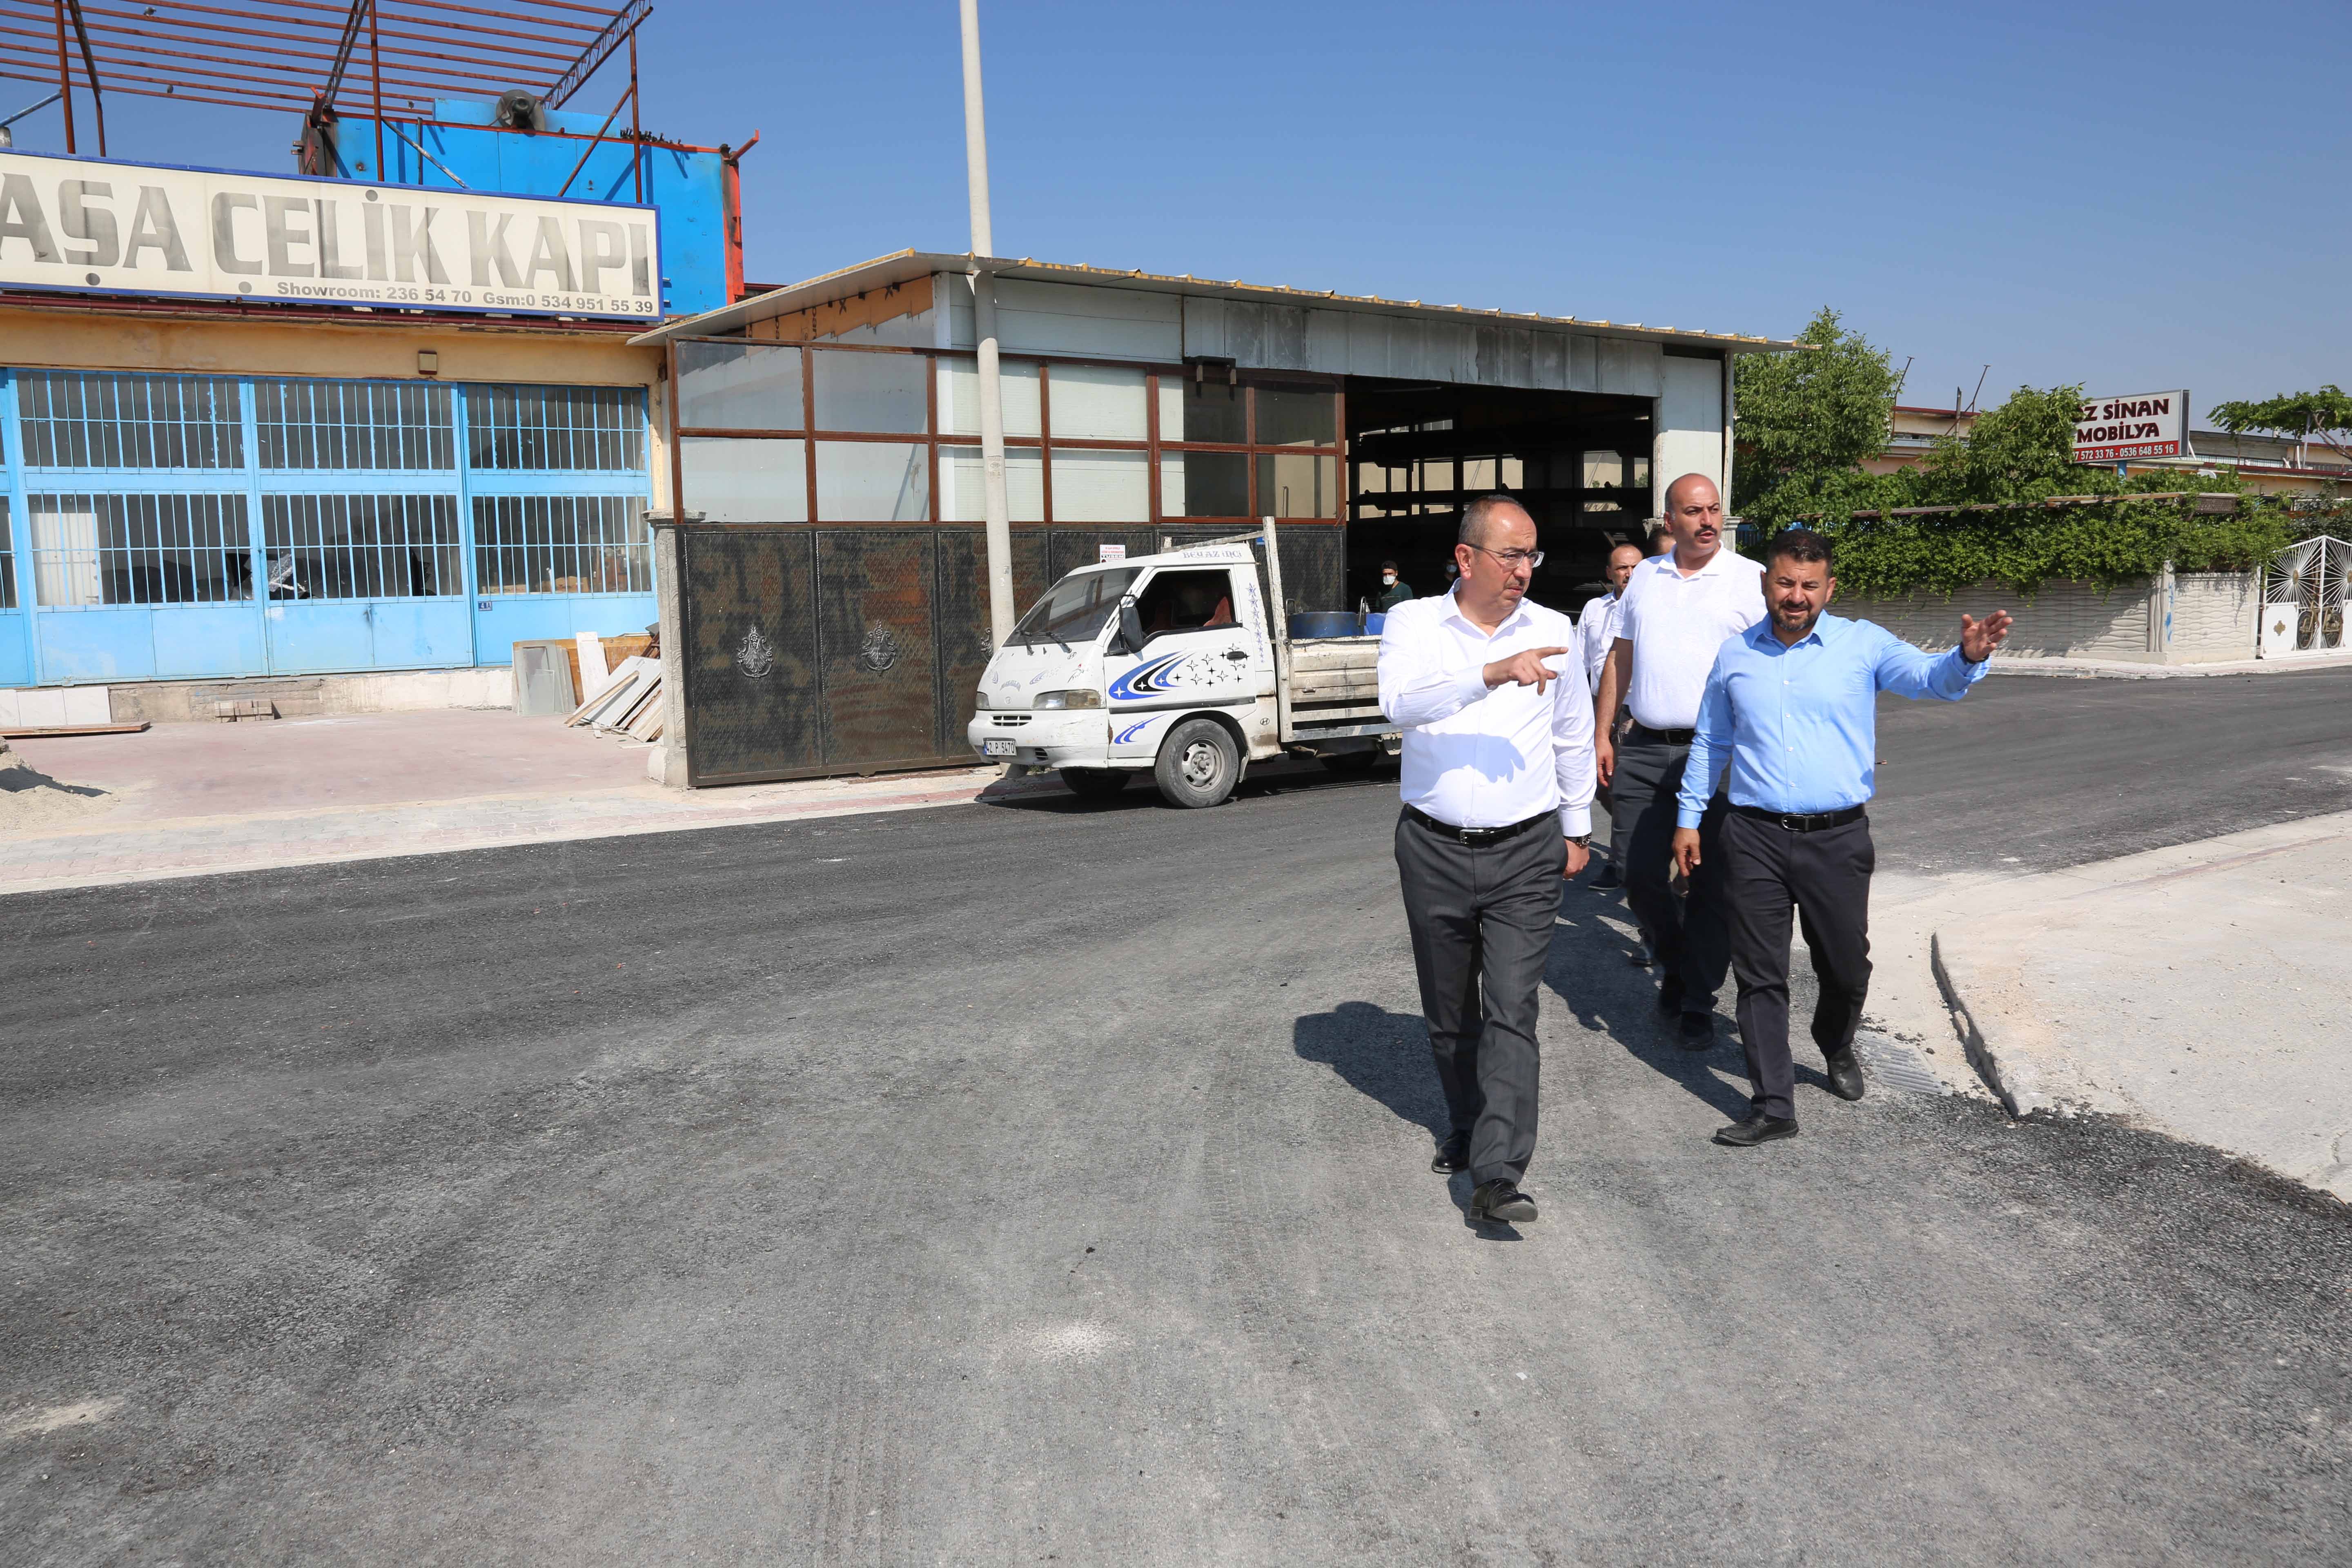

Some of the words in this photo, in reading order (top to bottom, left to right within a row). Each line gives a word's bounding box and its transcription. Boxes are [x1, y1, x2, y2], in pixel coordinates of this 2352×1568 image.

[211, 189, 452, 294] ÇELİK
[466, 210, 651, 297] KAPI
[277, 282, 381, 299] Showroom:
[386, 287, 419, 301] 236
[424, 289, 446, 301] 54
[451, 290, 472, 303] 70
[541, 295, 571, 308] 534
[577, 297, 604, 310] 951
[611, 300, 630, 312] 55
[635, 301, 653, 313] 39
[2103, 399, 2169, 420] SİNAN
[2077, 421, 2160, 443] MOBİLYA
[2081, 450, 2093, 460] 572
[2095, 450, 2103, 459] 33
[2105, 449, 2114, 458] 76
[2120, 447, 2137, 457] 0536
[2139, 445, 2152, 455] 648
[2154, 445, 2163, 454] 55
[2165, 444, 2174, 453] 16
